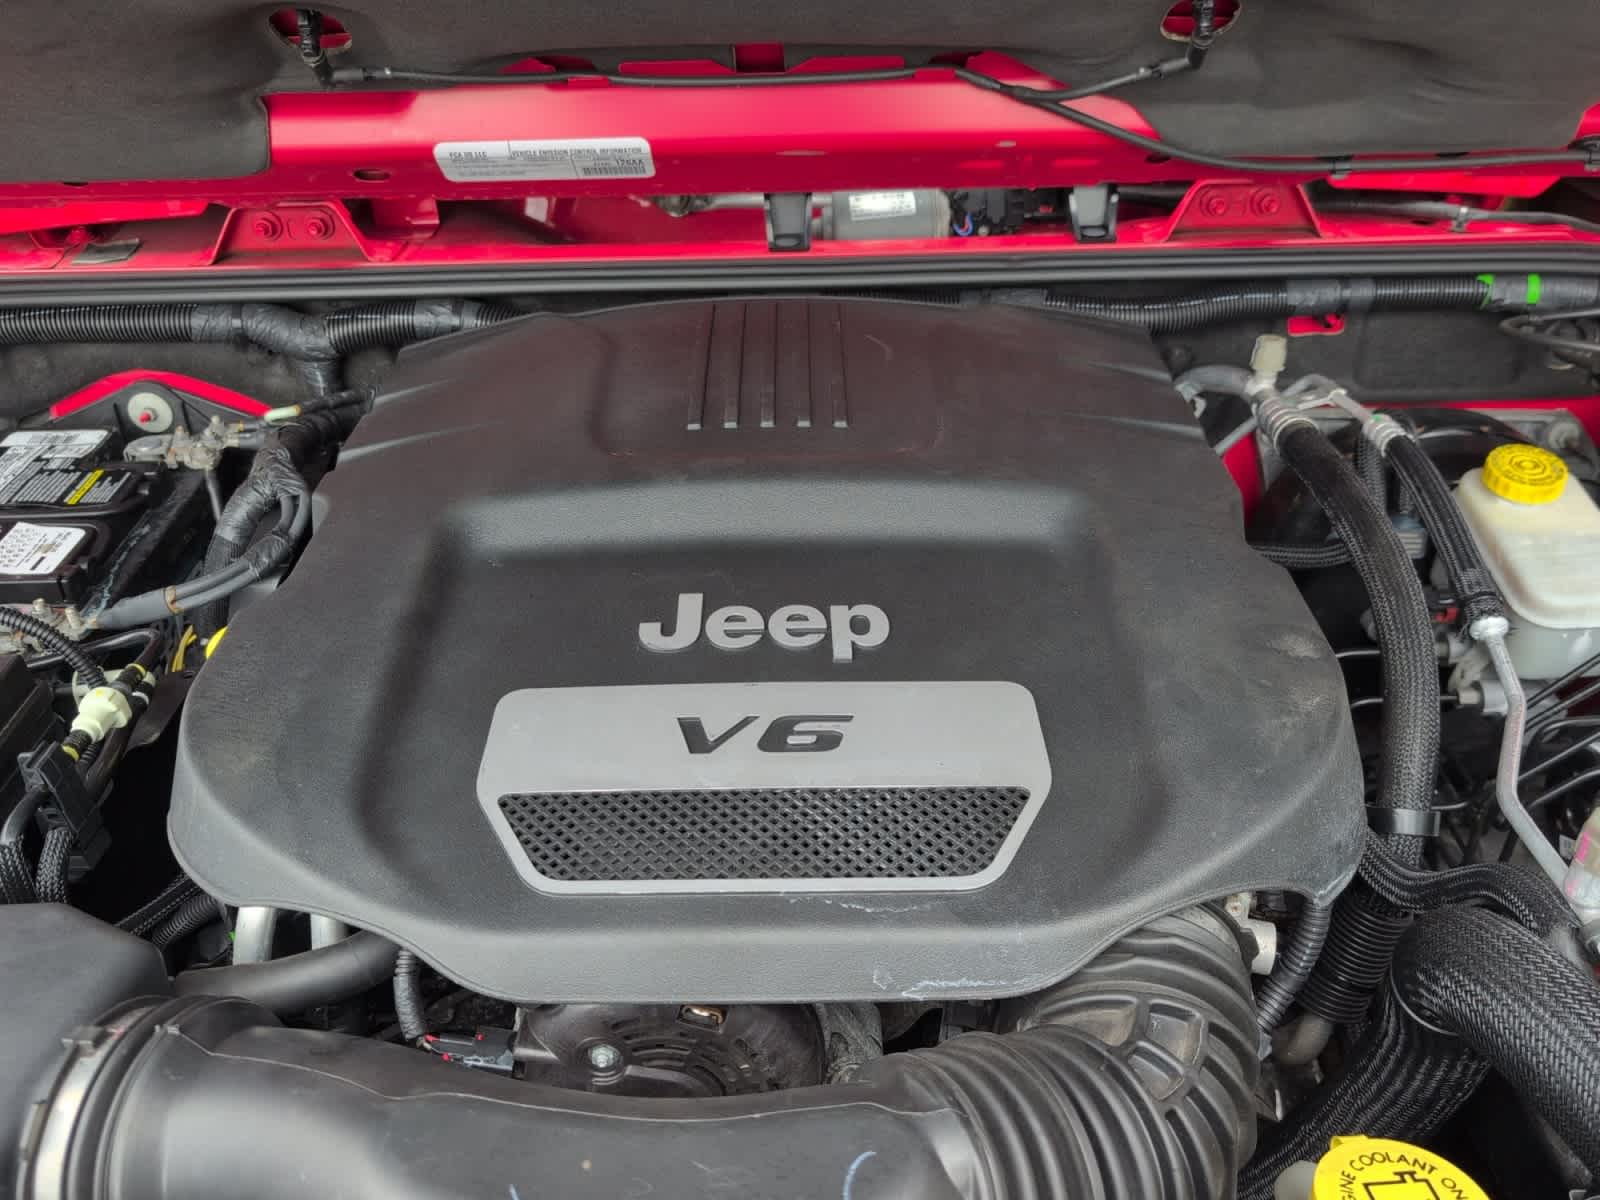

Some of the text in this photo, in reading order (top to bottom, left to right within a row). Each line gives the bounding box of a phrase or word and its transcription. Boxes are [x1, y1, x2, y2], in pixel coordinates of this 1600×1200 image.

[638, 593, 890, 663] Jeep
[677, 715, 854, 754] V6
[1349, 1152, 1438, 1175] COOLANT
